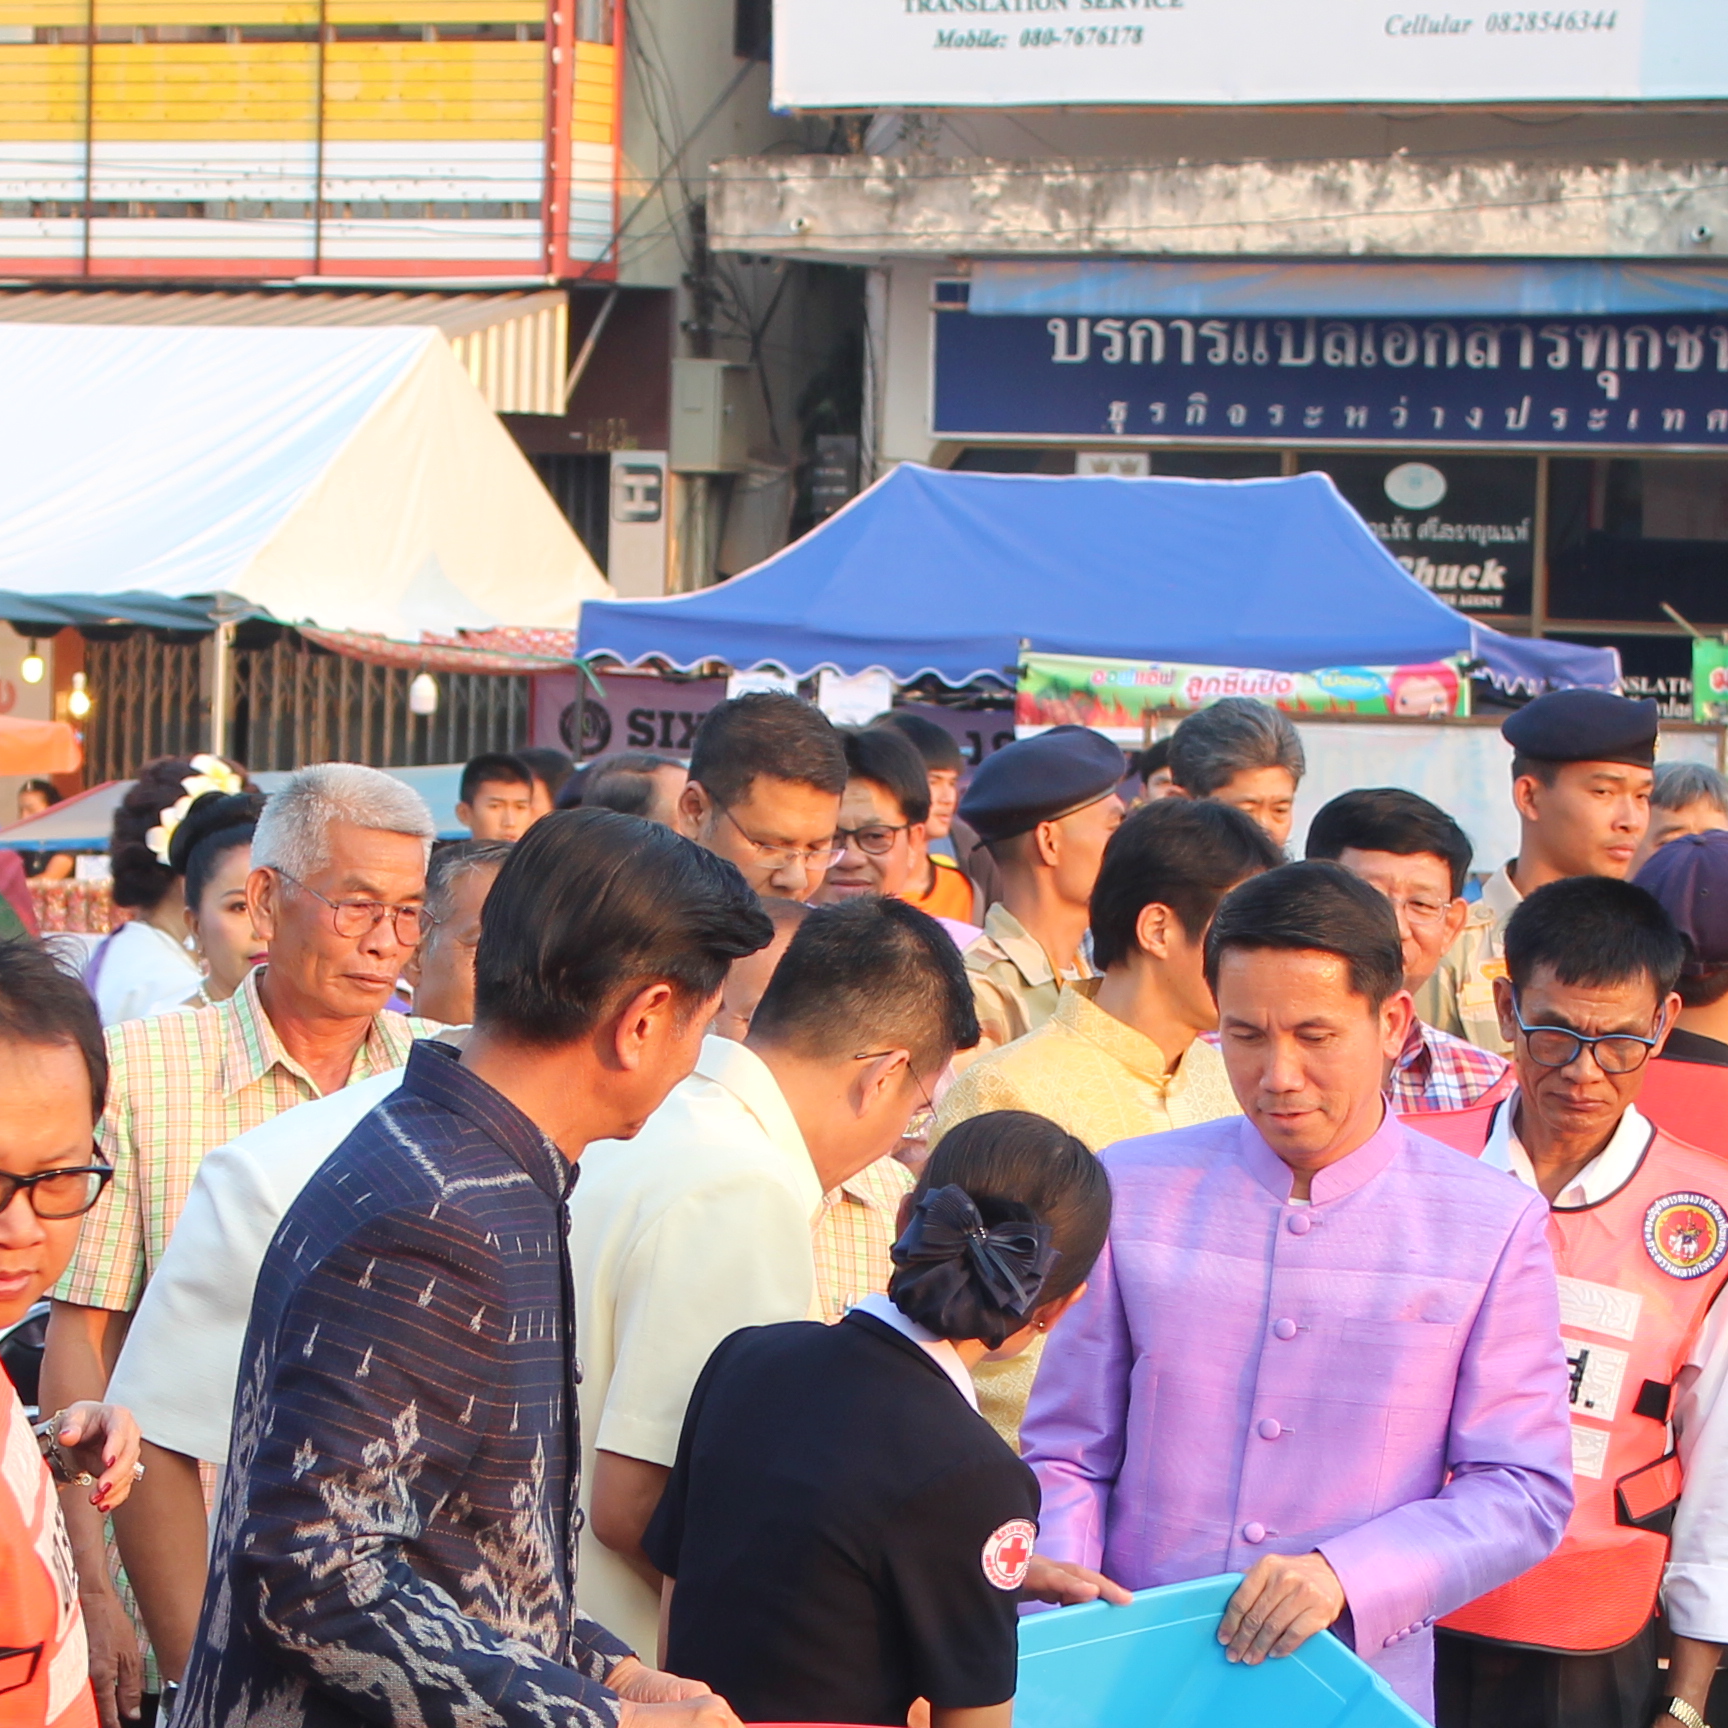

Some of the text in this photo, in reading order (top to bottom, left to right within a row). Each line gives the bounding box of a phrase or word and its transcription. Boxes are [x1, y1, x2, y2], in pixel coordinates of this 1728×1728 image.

[1384, 8, 1619, 36] Cellular 0828546344
[933, 25, 1145, 49] Mobile: 080-7676178
